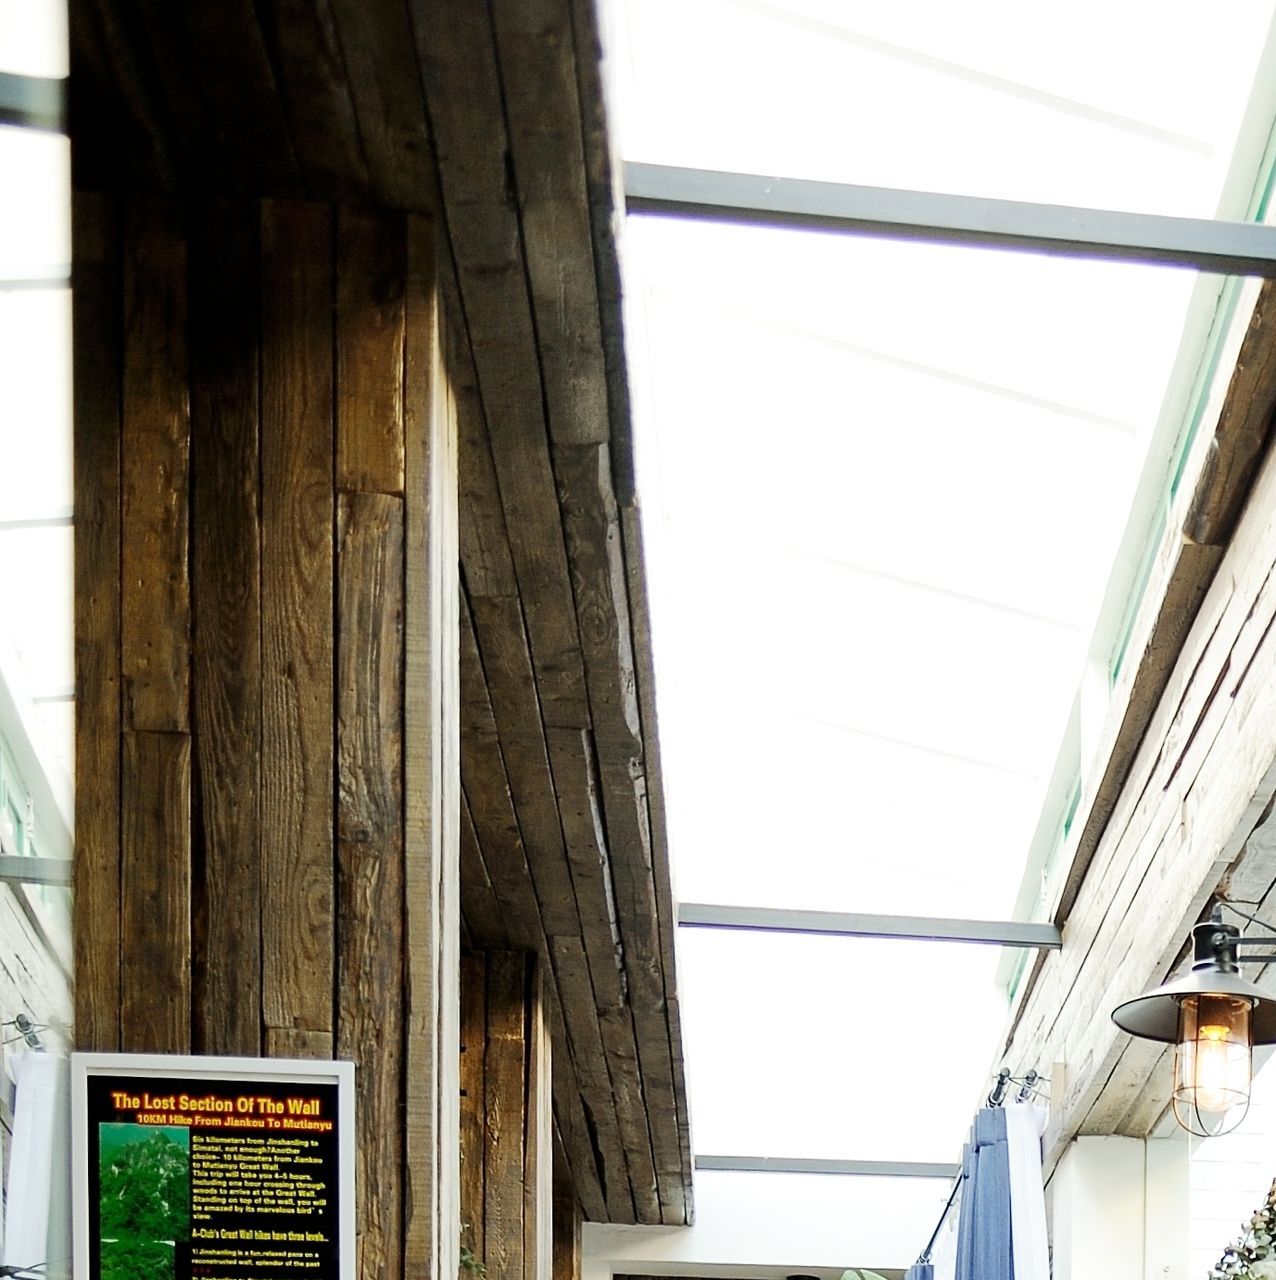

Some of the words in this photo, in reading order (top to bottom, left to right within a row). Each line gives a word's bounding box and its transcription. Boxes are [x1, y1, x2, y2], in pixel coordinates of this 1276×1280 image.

[113, 1093, 140, 1108] The
[145, 1094, 175, 1110] Lost
[180, 1096, 233, 1111] Section
[237, 1098, 254, 1112] Of
[257, 1098, 284, 1113] The
[288, 1100, 319, 1115] Wall
[138, 1114, 166, 1123] 10KM
[169, 1115, 192, 1124] Hike
[195, 1116, 221, 1125] From
[224, 1117, 264, 1127] Jiankou
[268, 1118, 280, 1127] To
[283, 1119, 332, 1131] Mutianyu
